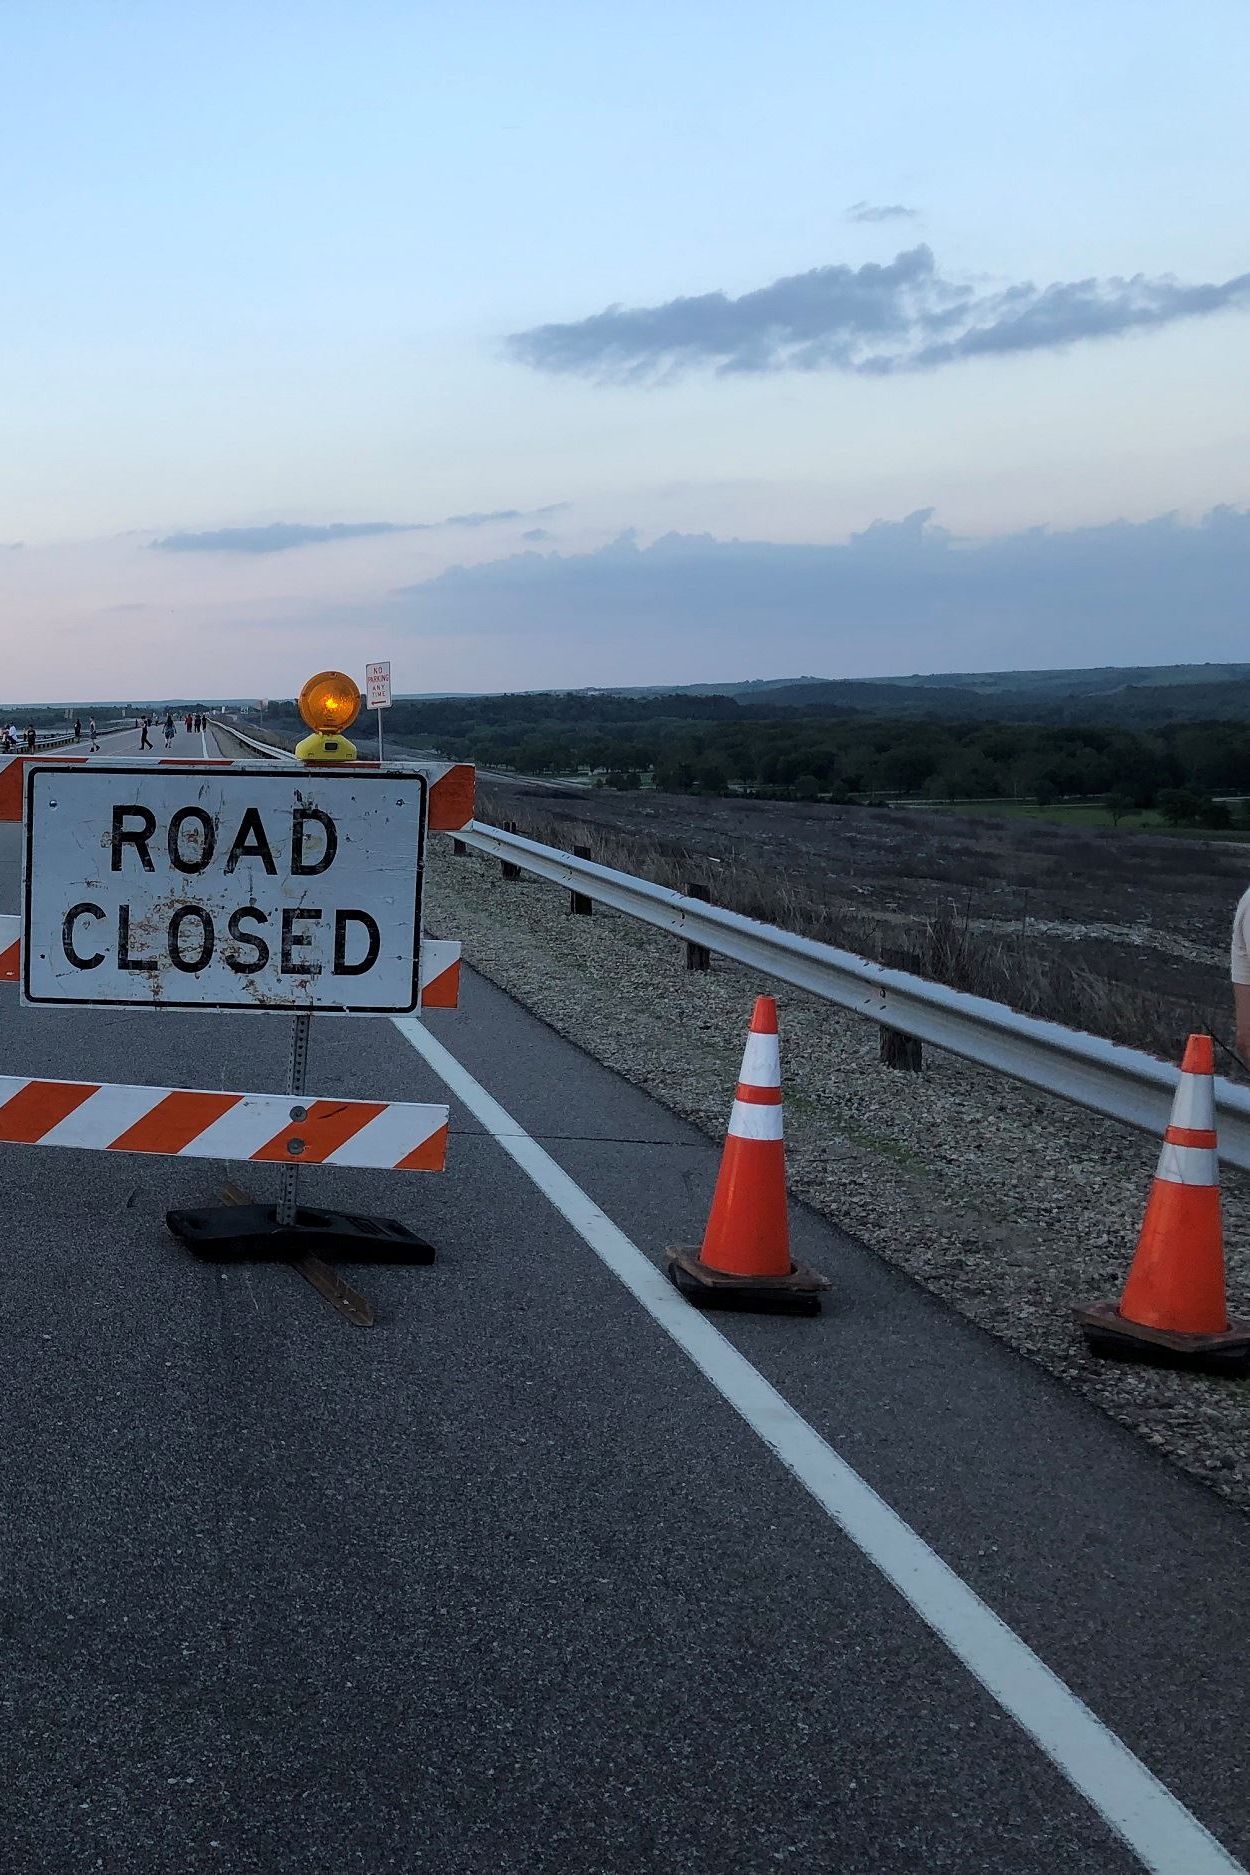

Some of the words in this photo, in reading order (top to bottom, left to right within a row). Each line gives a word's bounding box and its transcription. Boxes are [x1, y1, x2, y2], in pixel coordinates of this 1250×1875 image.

[367, 674, 389, 682] PARKING
[373, 666, 383, 674] NO
[110, 804, 338, 876] ROAD
[61, 902, 381, 977] CLOSED
